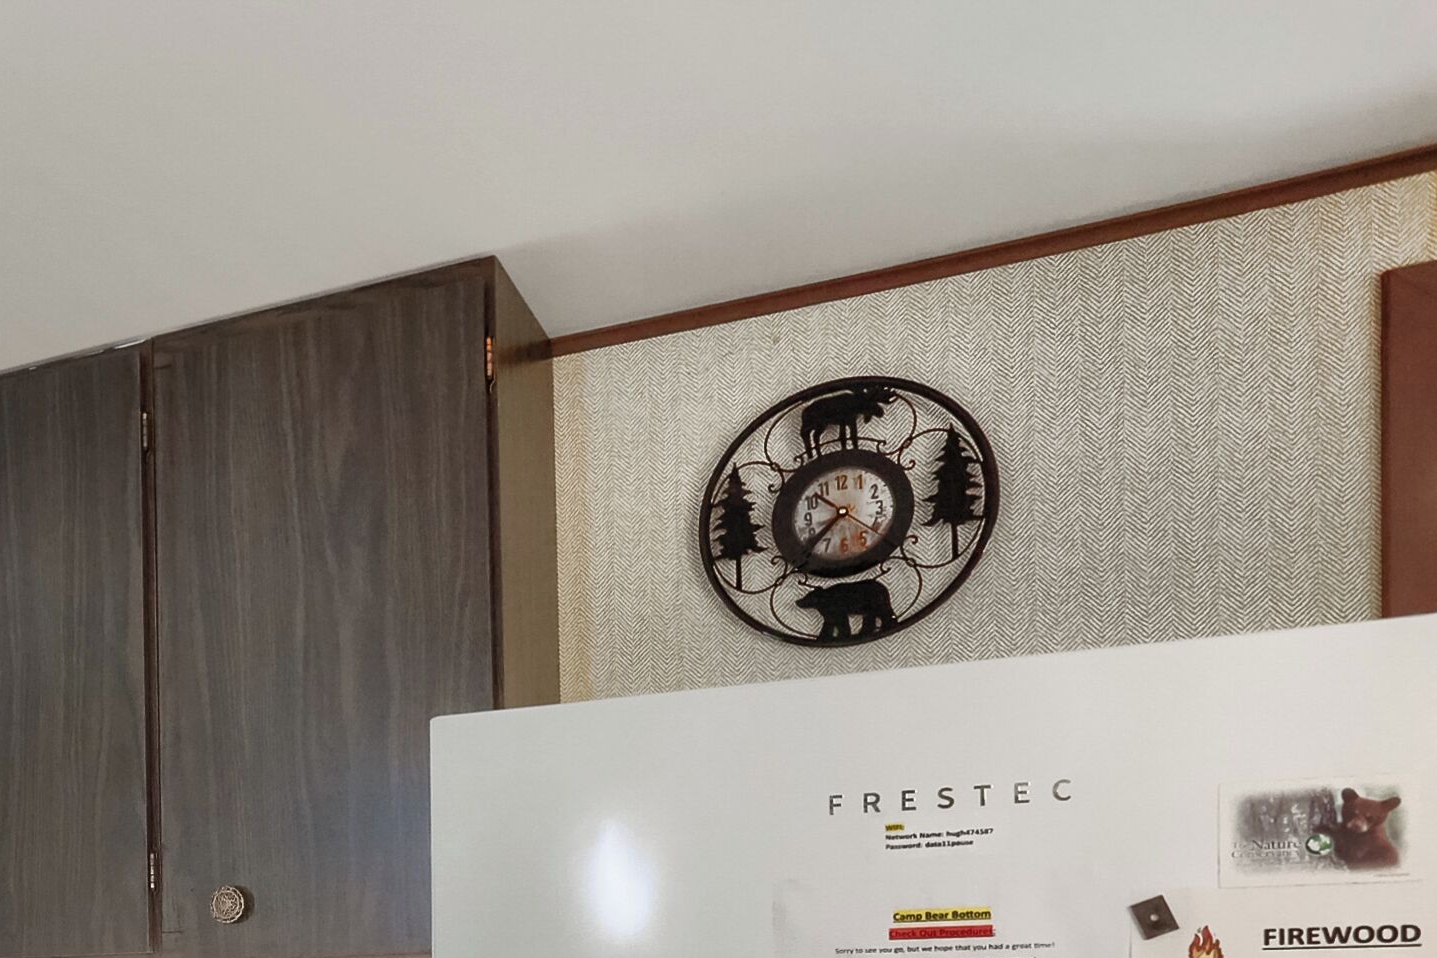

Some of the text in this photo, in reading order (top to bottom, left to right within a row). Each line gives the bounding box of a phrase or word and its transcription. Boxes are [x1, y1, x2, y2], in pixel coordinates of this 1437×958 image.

[819, 481, 829, 496] 11
[835, 474, 848, 490] 12
[857, 474, 863, 490] 1
[870, 484, 879, 499] 2
[805, 494, 818, 510] 10
[875, 500, 883, 515] 3
[804, 512, 813, 526] 9
[823, 538, 831, 553] 7
[840, 537, 848, 553] 6
[828, 779, 1072, 815] FRESTEC
[1252, 840, 1301, 850] Nature
[1263, 924, 1421, 946] FIREWOOD
